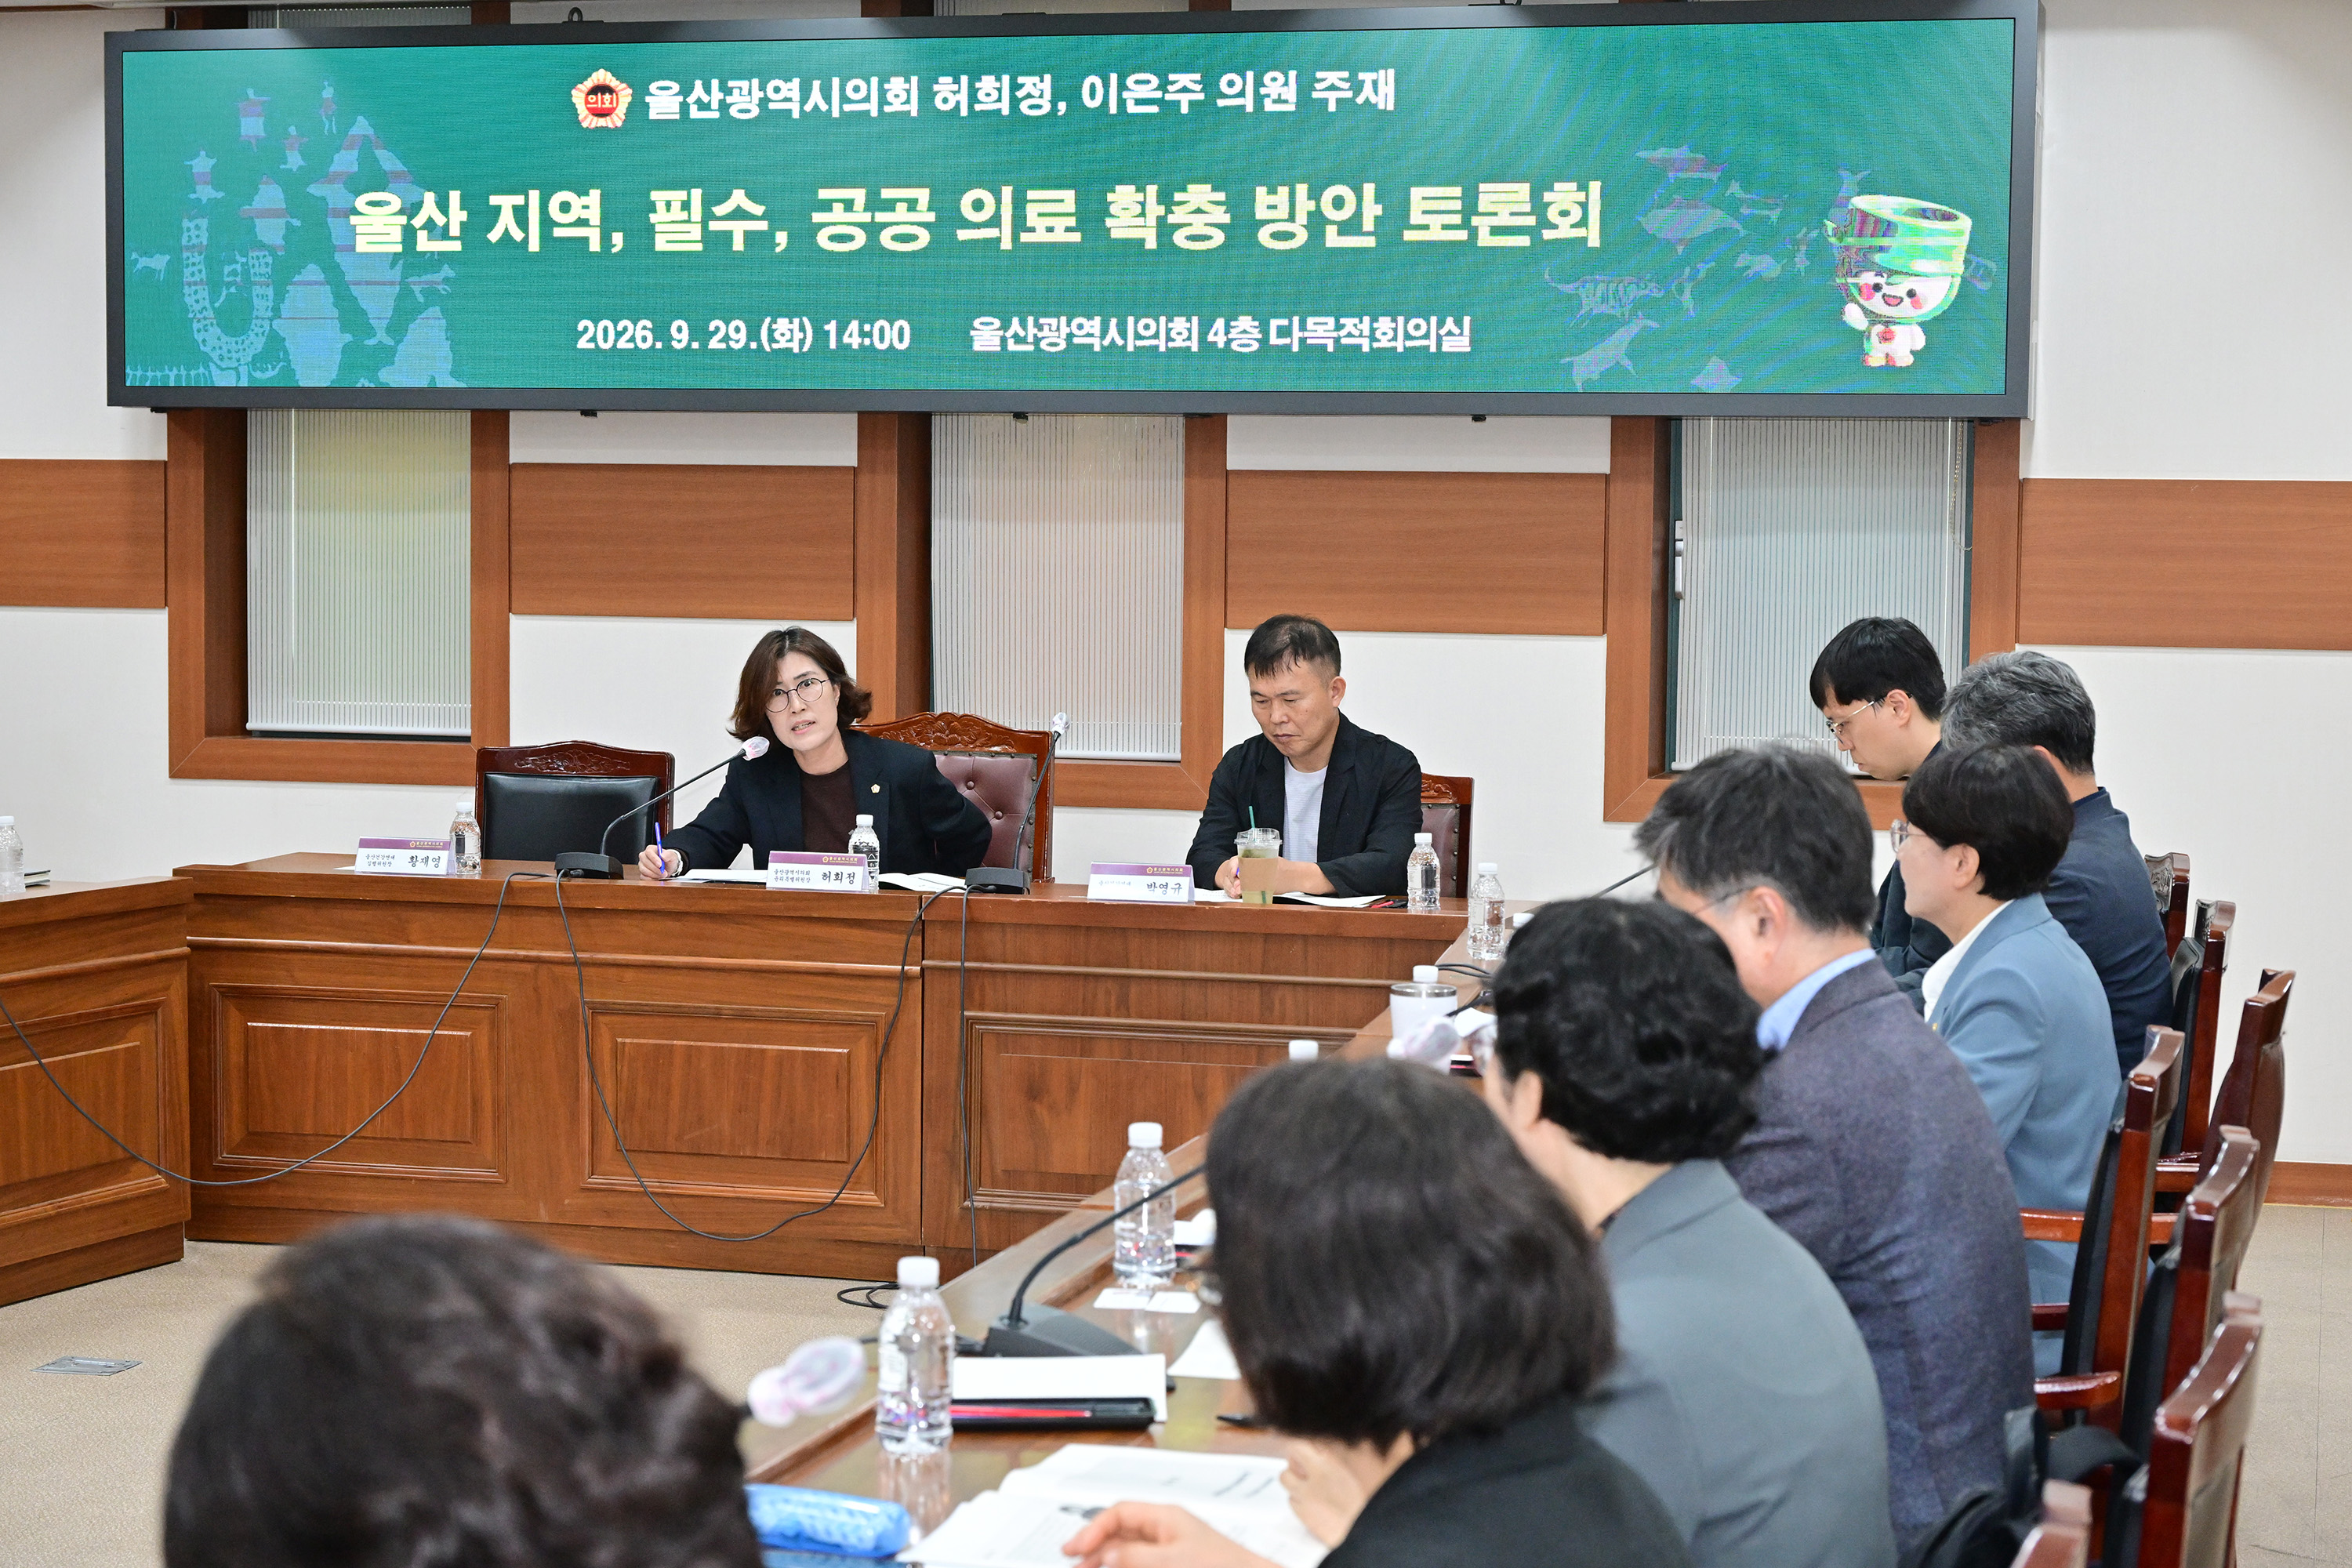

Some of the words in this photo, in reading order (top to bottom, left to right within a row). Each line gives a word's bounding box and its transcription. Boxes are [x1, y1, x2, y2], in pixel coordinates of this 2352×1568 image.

[586, 92, 616, 107] 의회
[644, 75, 918, 120] 울산광역시의회
[933, 74, 1067, 117] 허희정,
[1082, 72, 1205, 114] 이은주
[1216, 70, 1298, 113] 의원
[1312, 68, 1395, 112] 주재
[349, 190, 468, 253] 울산
[486, 189, 623, 253] 지역,
[648, 188, 788, 253] 필수,
[811, 187, 936, 252] 공공
[956, 185, 1082, 250] 의료
[1105, 183, 1231, 250] 확충
[1254, 183, 1383, 250] 방안
[1403, 180, 1602, 248] 토론회
[576, 319, 662, 350] 2026.
[670, 319, 699, 350] 9.
[823, 319, 910, 350] 14:00
[970, 315, 1199, 353] 울산광역시의회
[1207, 315, 1263, 353] 4층
[1269, 315, 1472, 353] 다목적회의실
[408, 855, 441, 869] 황재영
[1147, 881, 1182, 895] 박영규
